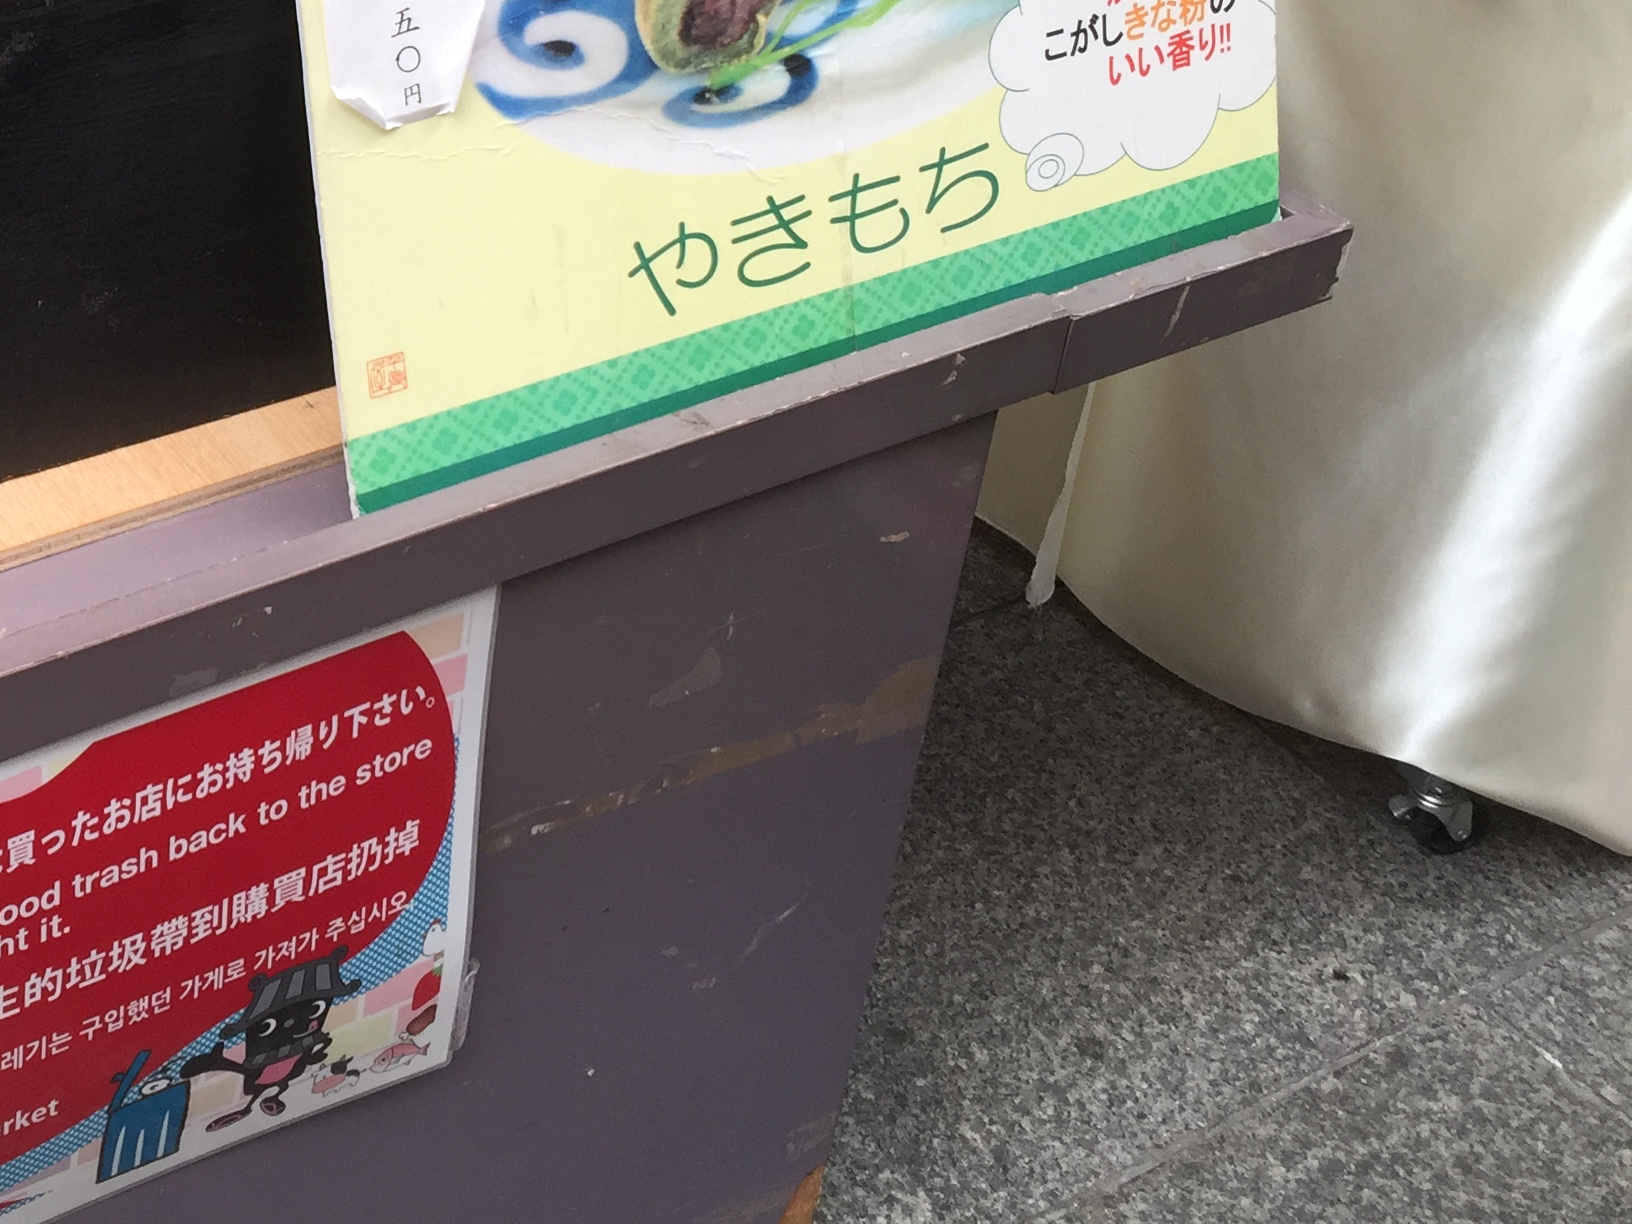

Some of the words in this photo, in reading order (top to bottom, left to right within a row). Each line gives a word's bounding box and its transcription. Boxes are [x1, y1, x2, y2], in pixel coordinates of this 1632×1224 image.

[628, 142, 1000, 317] やきもち
[71, 846, 159, 898] trash
[168, 812, 247, 862] back
[257, 798, 289, 826] to
[297, 774, 347, 810] the
[354, 738, 434, 786] store
[39, 913, 71, 944] it.
[78, 985, 172, 1042] 구입했던
[178, 958, 247, 1001] 가게로
[253, 928, 319, 971] 가져가
